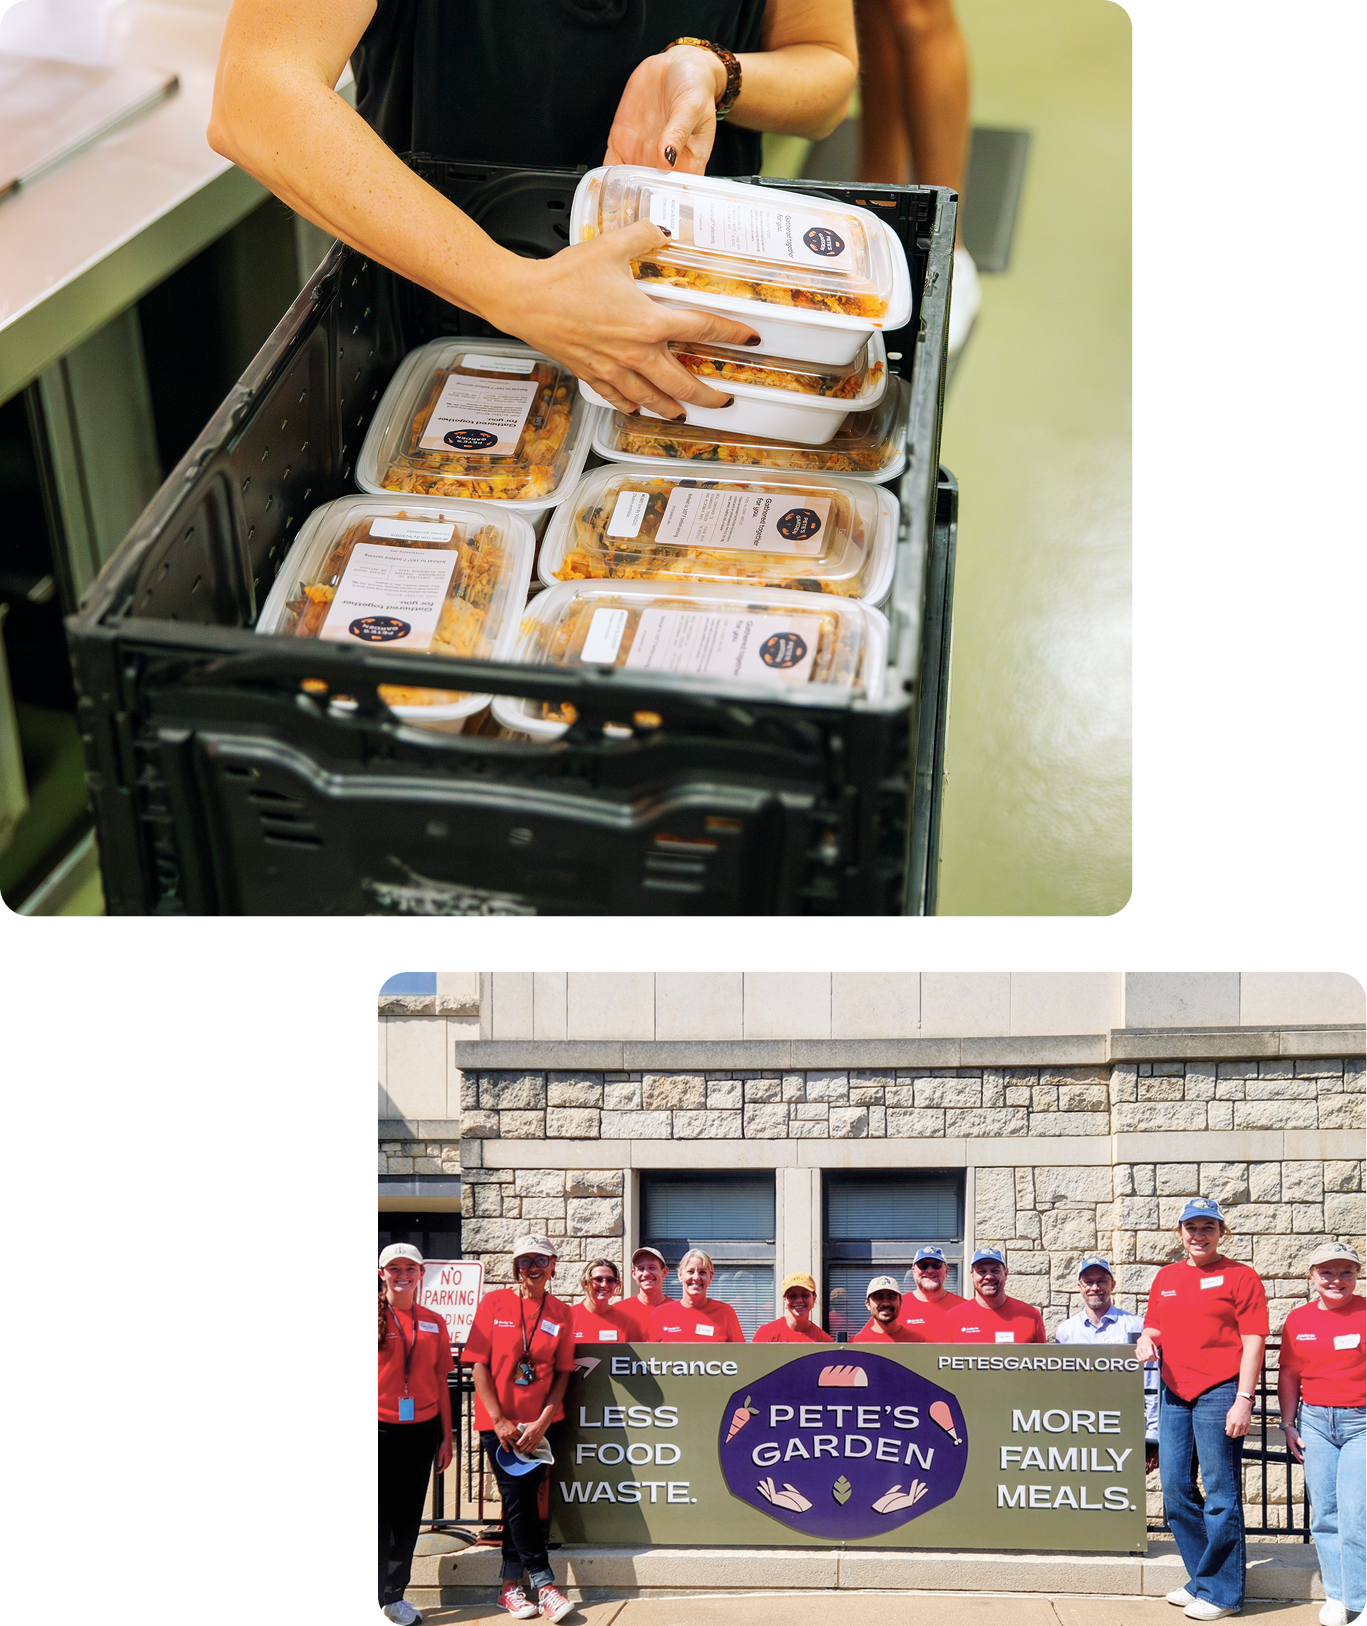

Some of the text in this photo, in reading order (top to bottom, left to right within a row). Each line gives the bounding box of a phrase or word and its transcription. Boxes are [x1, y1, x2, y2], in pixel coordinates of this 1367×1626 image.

[775, 213, 783, 221] for
[784, 214, 794, 258] Gathered together
[818, 232, 826, 251] GARDEN
[751, 506, 760, 518] you.
[753, 498, 772, 546] Gathered together
[791, 514, 803, 534] GARDEN
[799, 516, 809, 533] PETE'S
[341, 600, 384, 609] together
[362, 623, 399, 631] GARDEN
[440, 1270, 462, 1286] NO
[424, 1289, 475, 1306] PARKING
[445, 1313, 473, 1326] DING
[611, 1356, 738, 1375] Entrance
[938, 1356, 1140, 1371] PETESGARDEN.ORG
[579, 1406, 679, 1428] LESS
[769, 1405, 920, 1429] PETE'S
[1012, 1409, 1121, 1434] MORE
[576, 1443, 681, 1466] FOOD
[751, 1434, 935, 1471] GARDEN
[1000, 1445, 1133, 1472] FAMILY
[559, 1481, 698, 1504] WASTE.
[997, 1484, 1137, 1511] MEALS.
